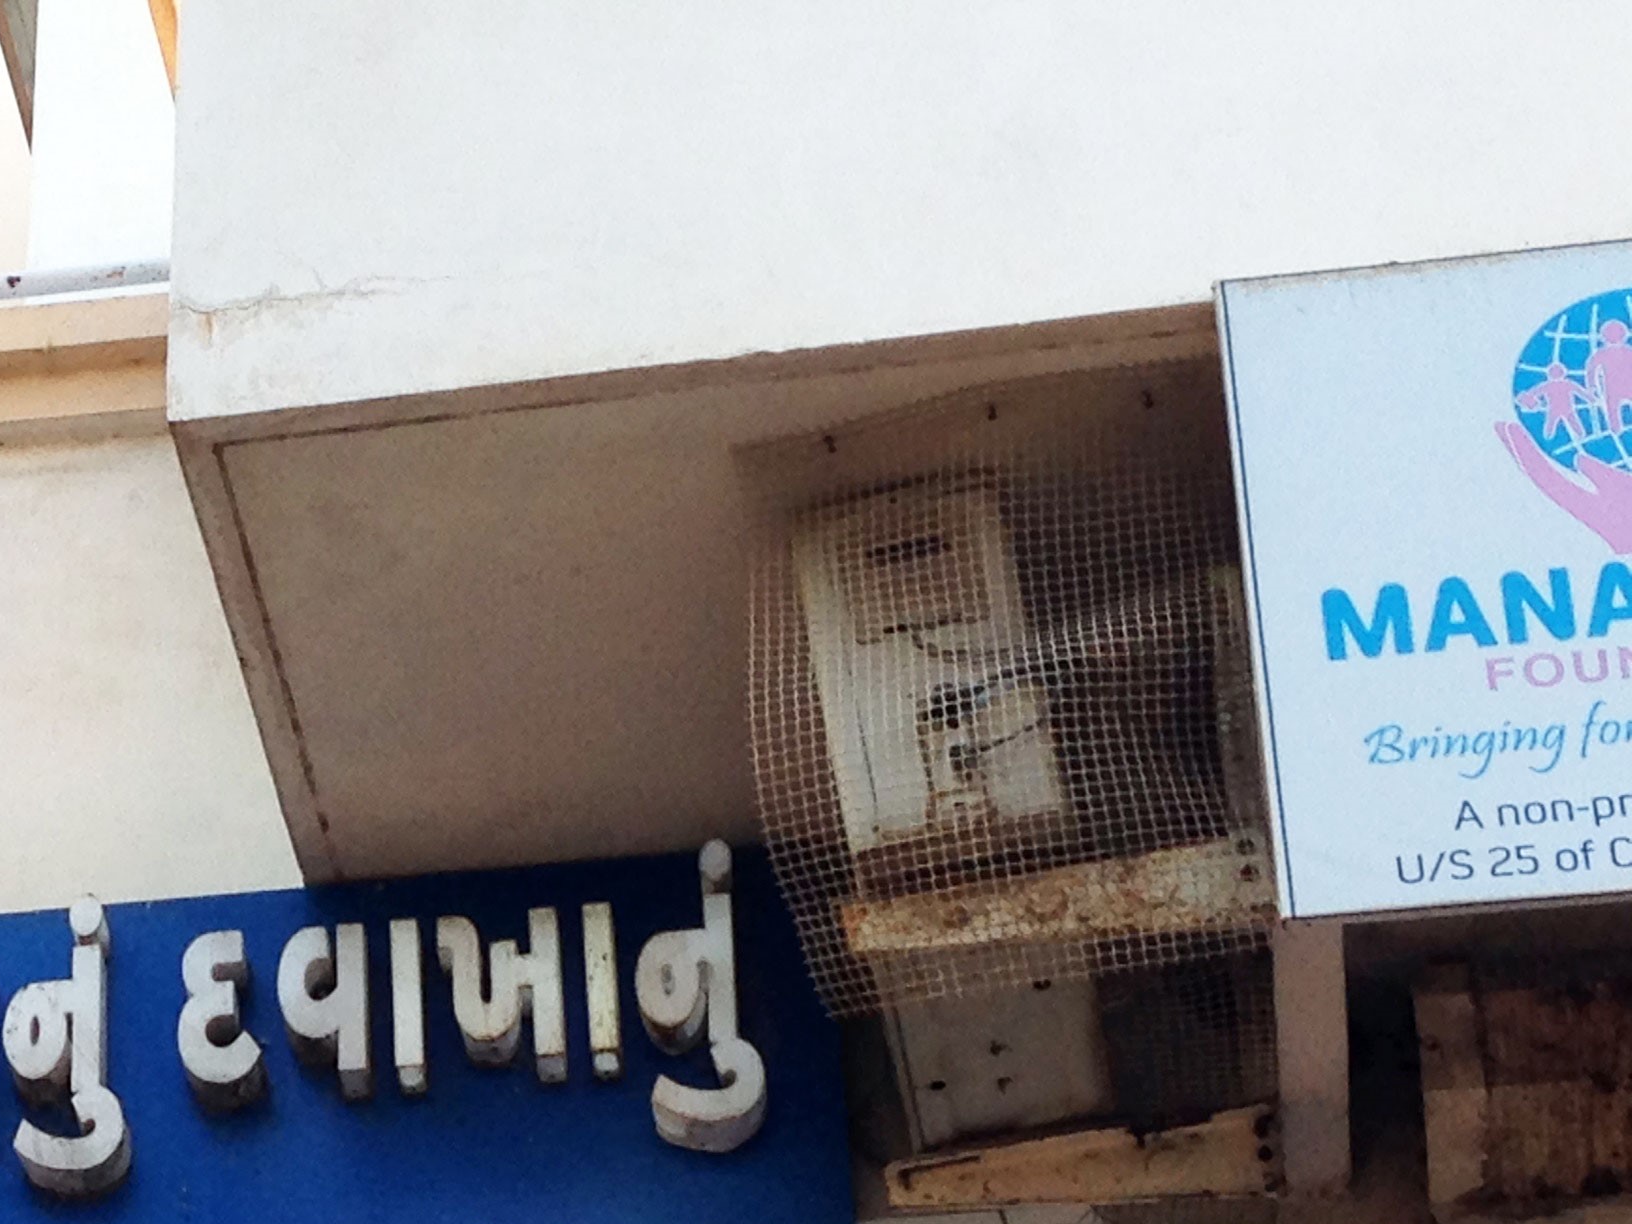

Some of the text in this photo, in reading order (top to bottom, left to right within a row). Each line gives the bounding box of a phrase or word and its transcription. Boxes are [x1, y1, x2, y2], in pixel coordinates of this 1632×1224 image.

[1320, 562, 1632, 661] MANA
[1364, 718, 1566, 779] Bringing
[1455, 800, 1484, 831] A
[1395, 850, 1475, 884] U/S
[1489, 846, 1540, 877] 25
[1556, 840, 1593, 872] of
[177, 839, 766, 1153] દવાખાનું
